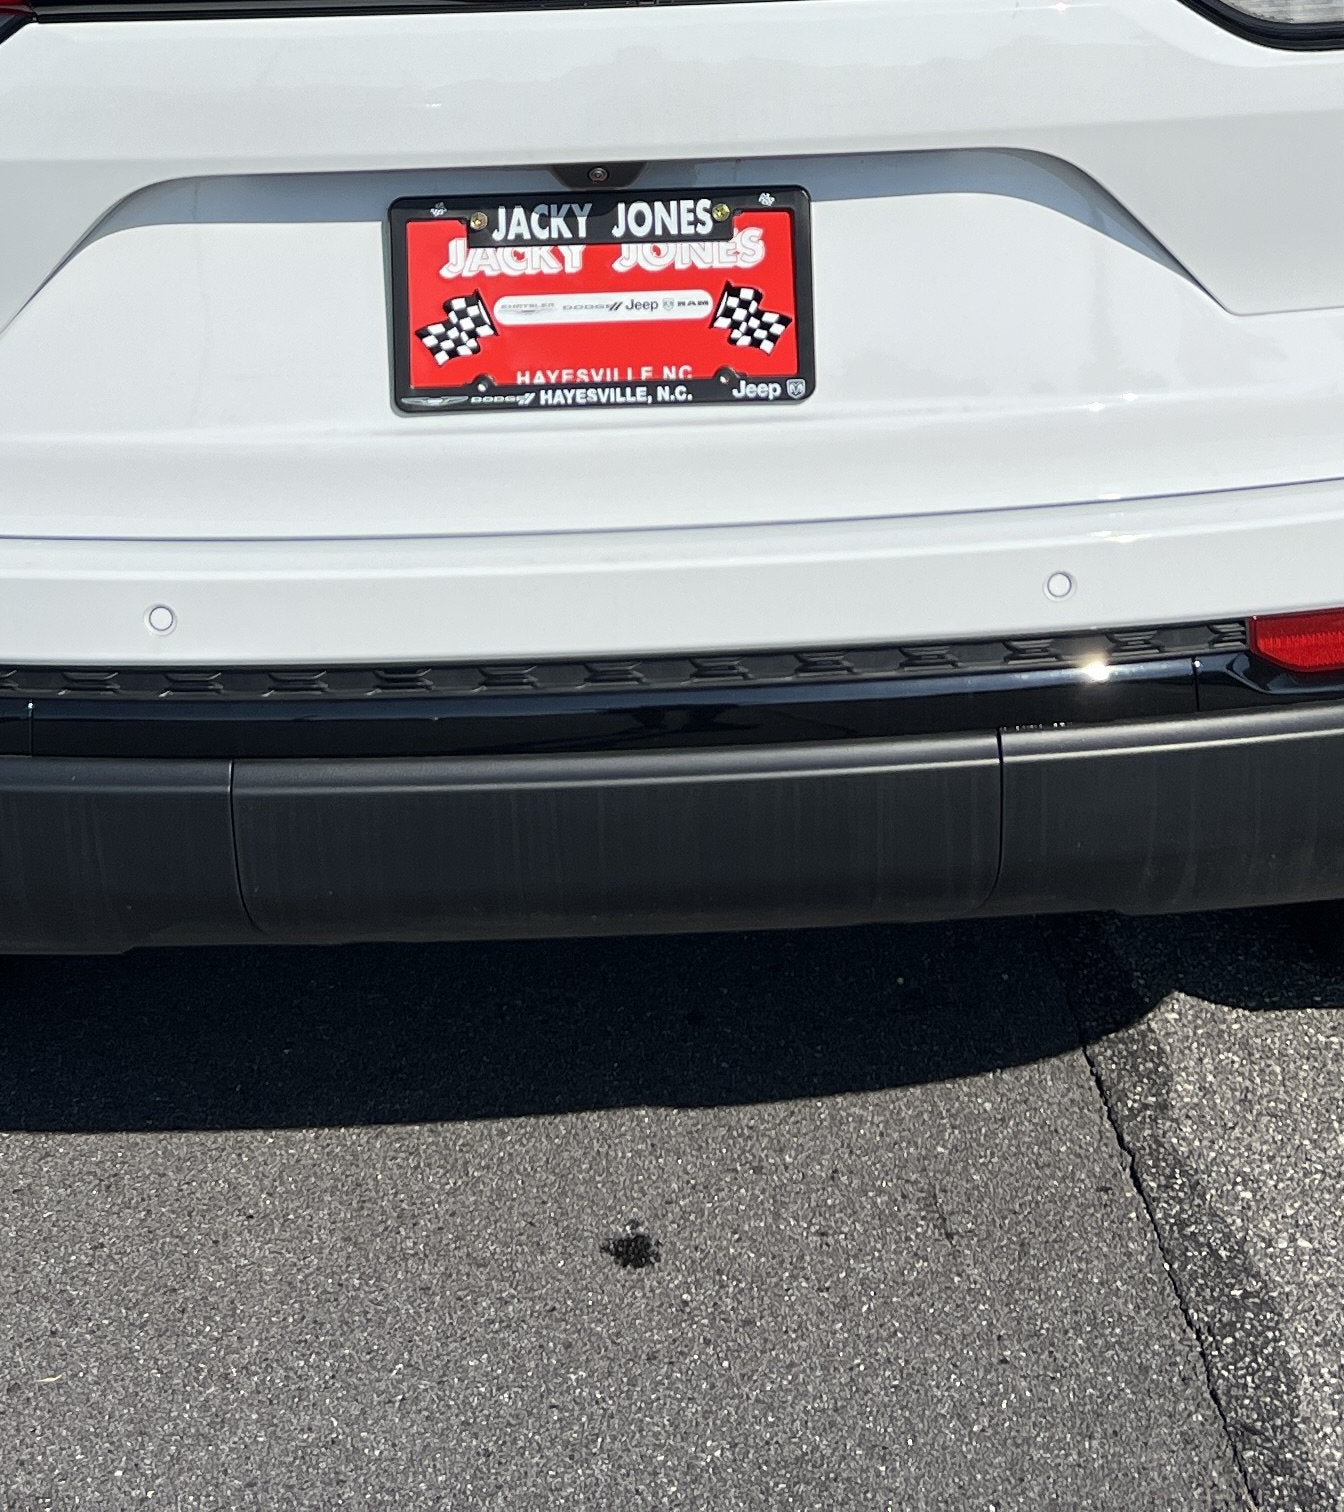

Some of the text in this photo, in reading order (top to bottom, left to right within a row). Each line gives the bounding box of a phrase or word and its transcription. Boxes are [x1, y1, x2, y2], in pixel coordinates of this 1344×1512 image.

[492, 199, 713, 241] JACKY JONES
[440, 226, 765, 279] JACKY JONES
[625, 299, 659, 311] Jeep
[662, 365, 693, 380] NC
[539, 387, 653, 405] HAYESVILLE,
[656, 385, 693, 402] N.C.
[732, 380, 782, 400] Jeep
